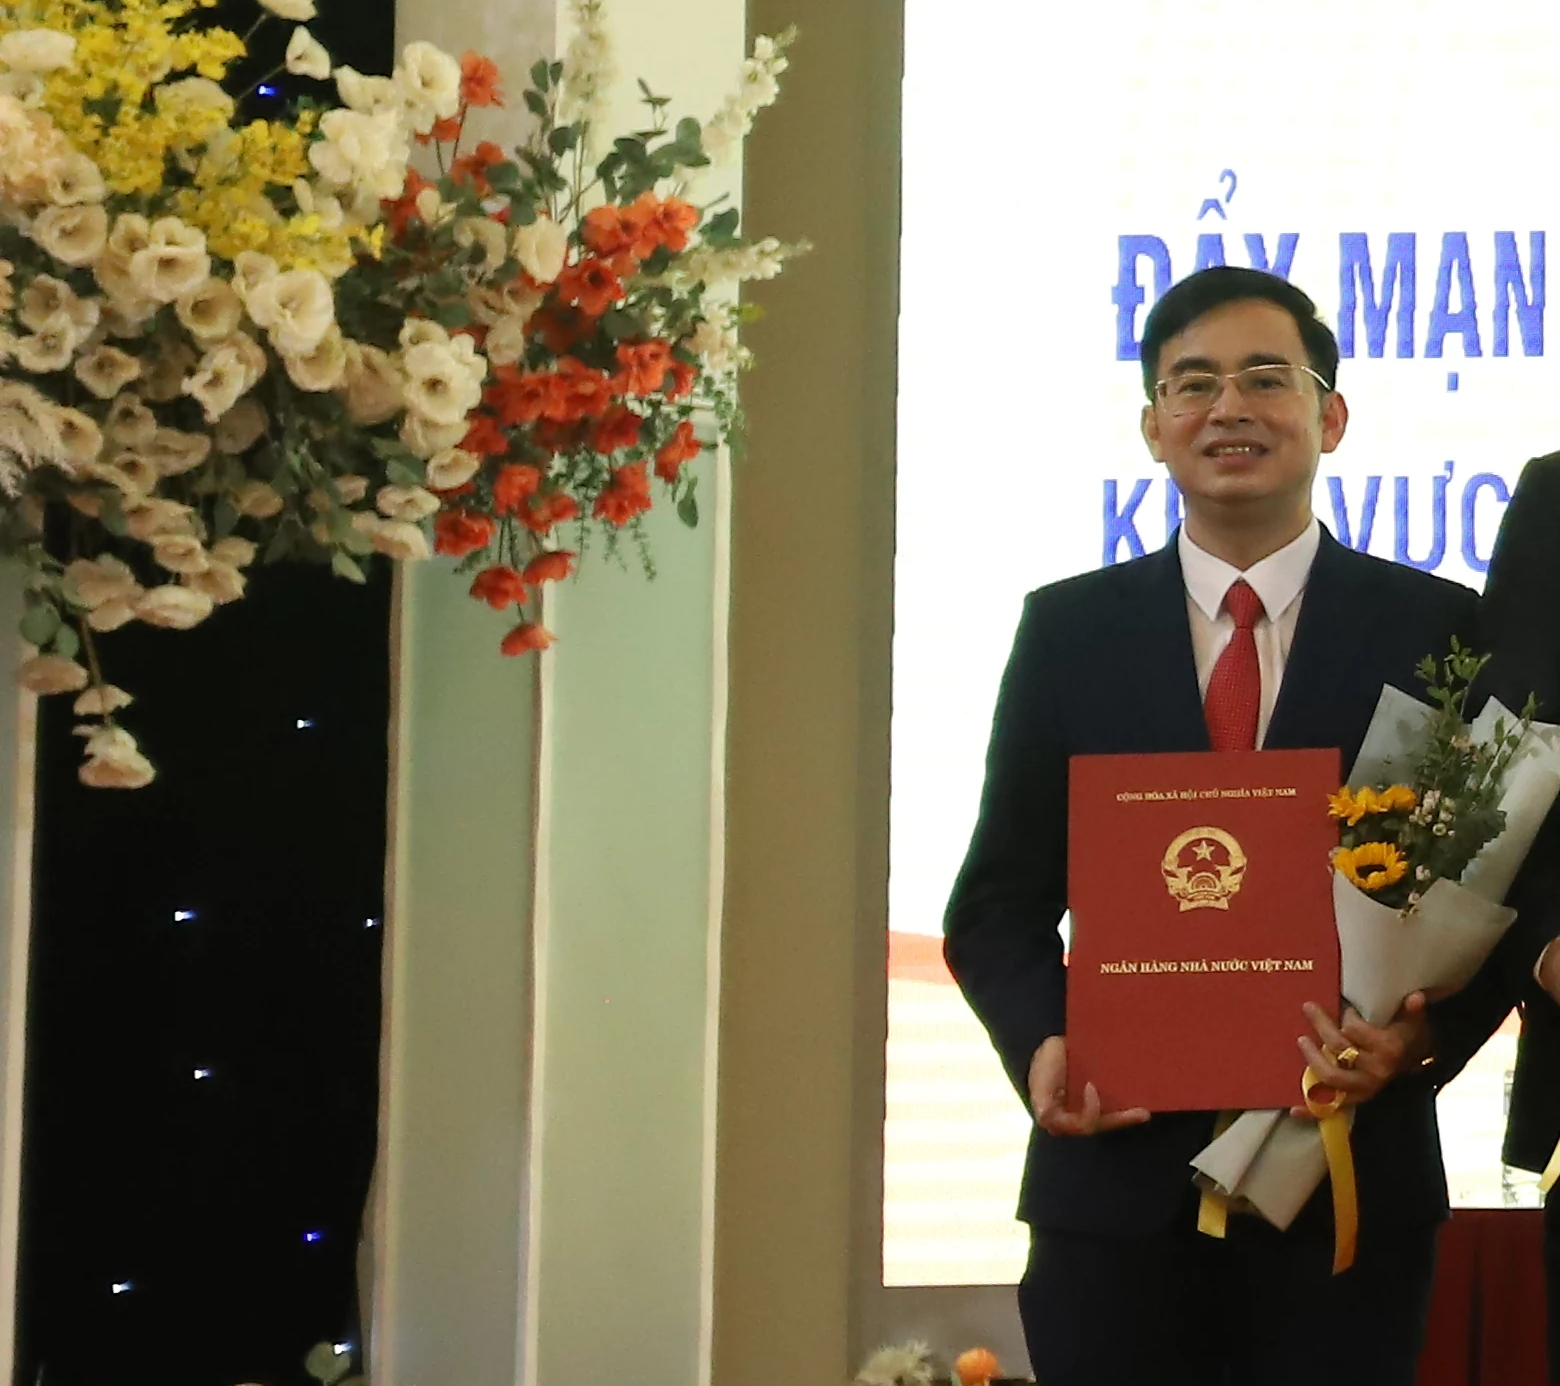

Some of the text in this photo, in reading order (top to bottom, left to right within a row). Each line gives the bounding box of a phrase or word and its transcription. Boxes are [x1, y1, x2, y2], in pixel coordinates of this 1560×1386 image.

[1275, 788, 1296, 797] NAM
[1100, 958, 1314, 973] NGÂN HÀNG NHÀ NƯỚC VIỆT NAM
